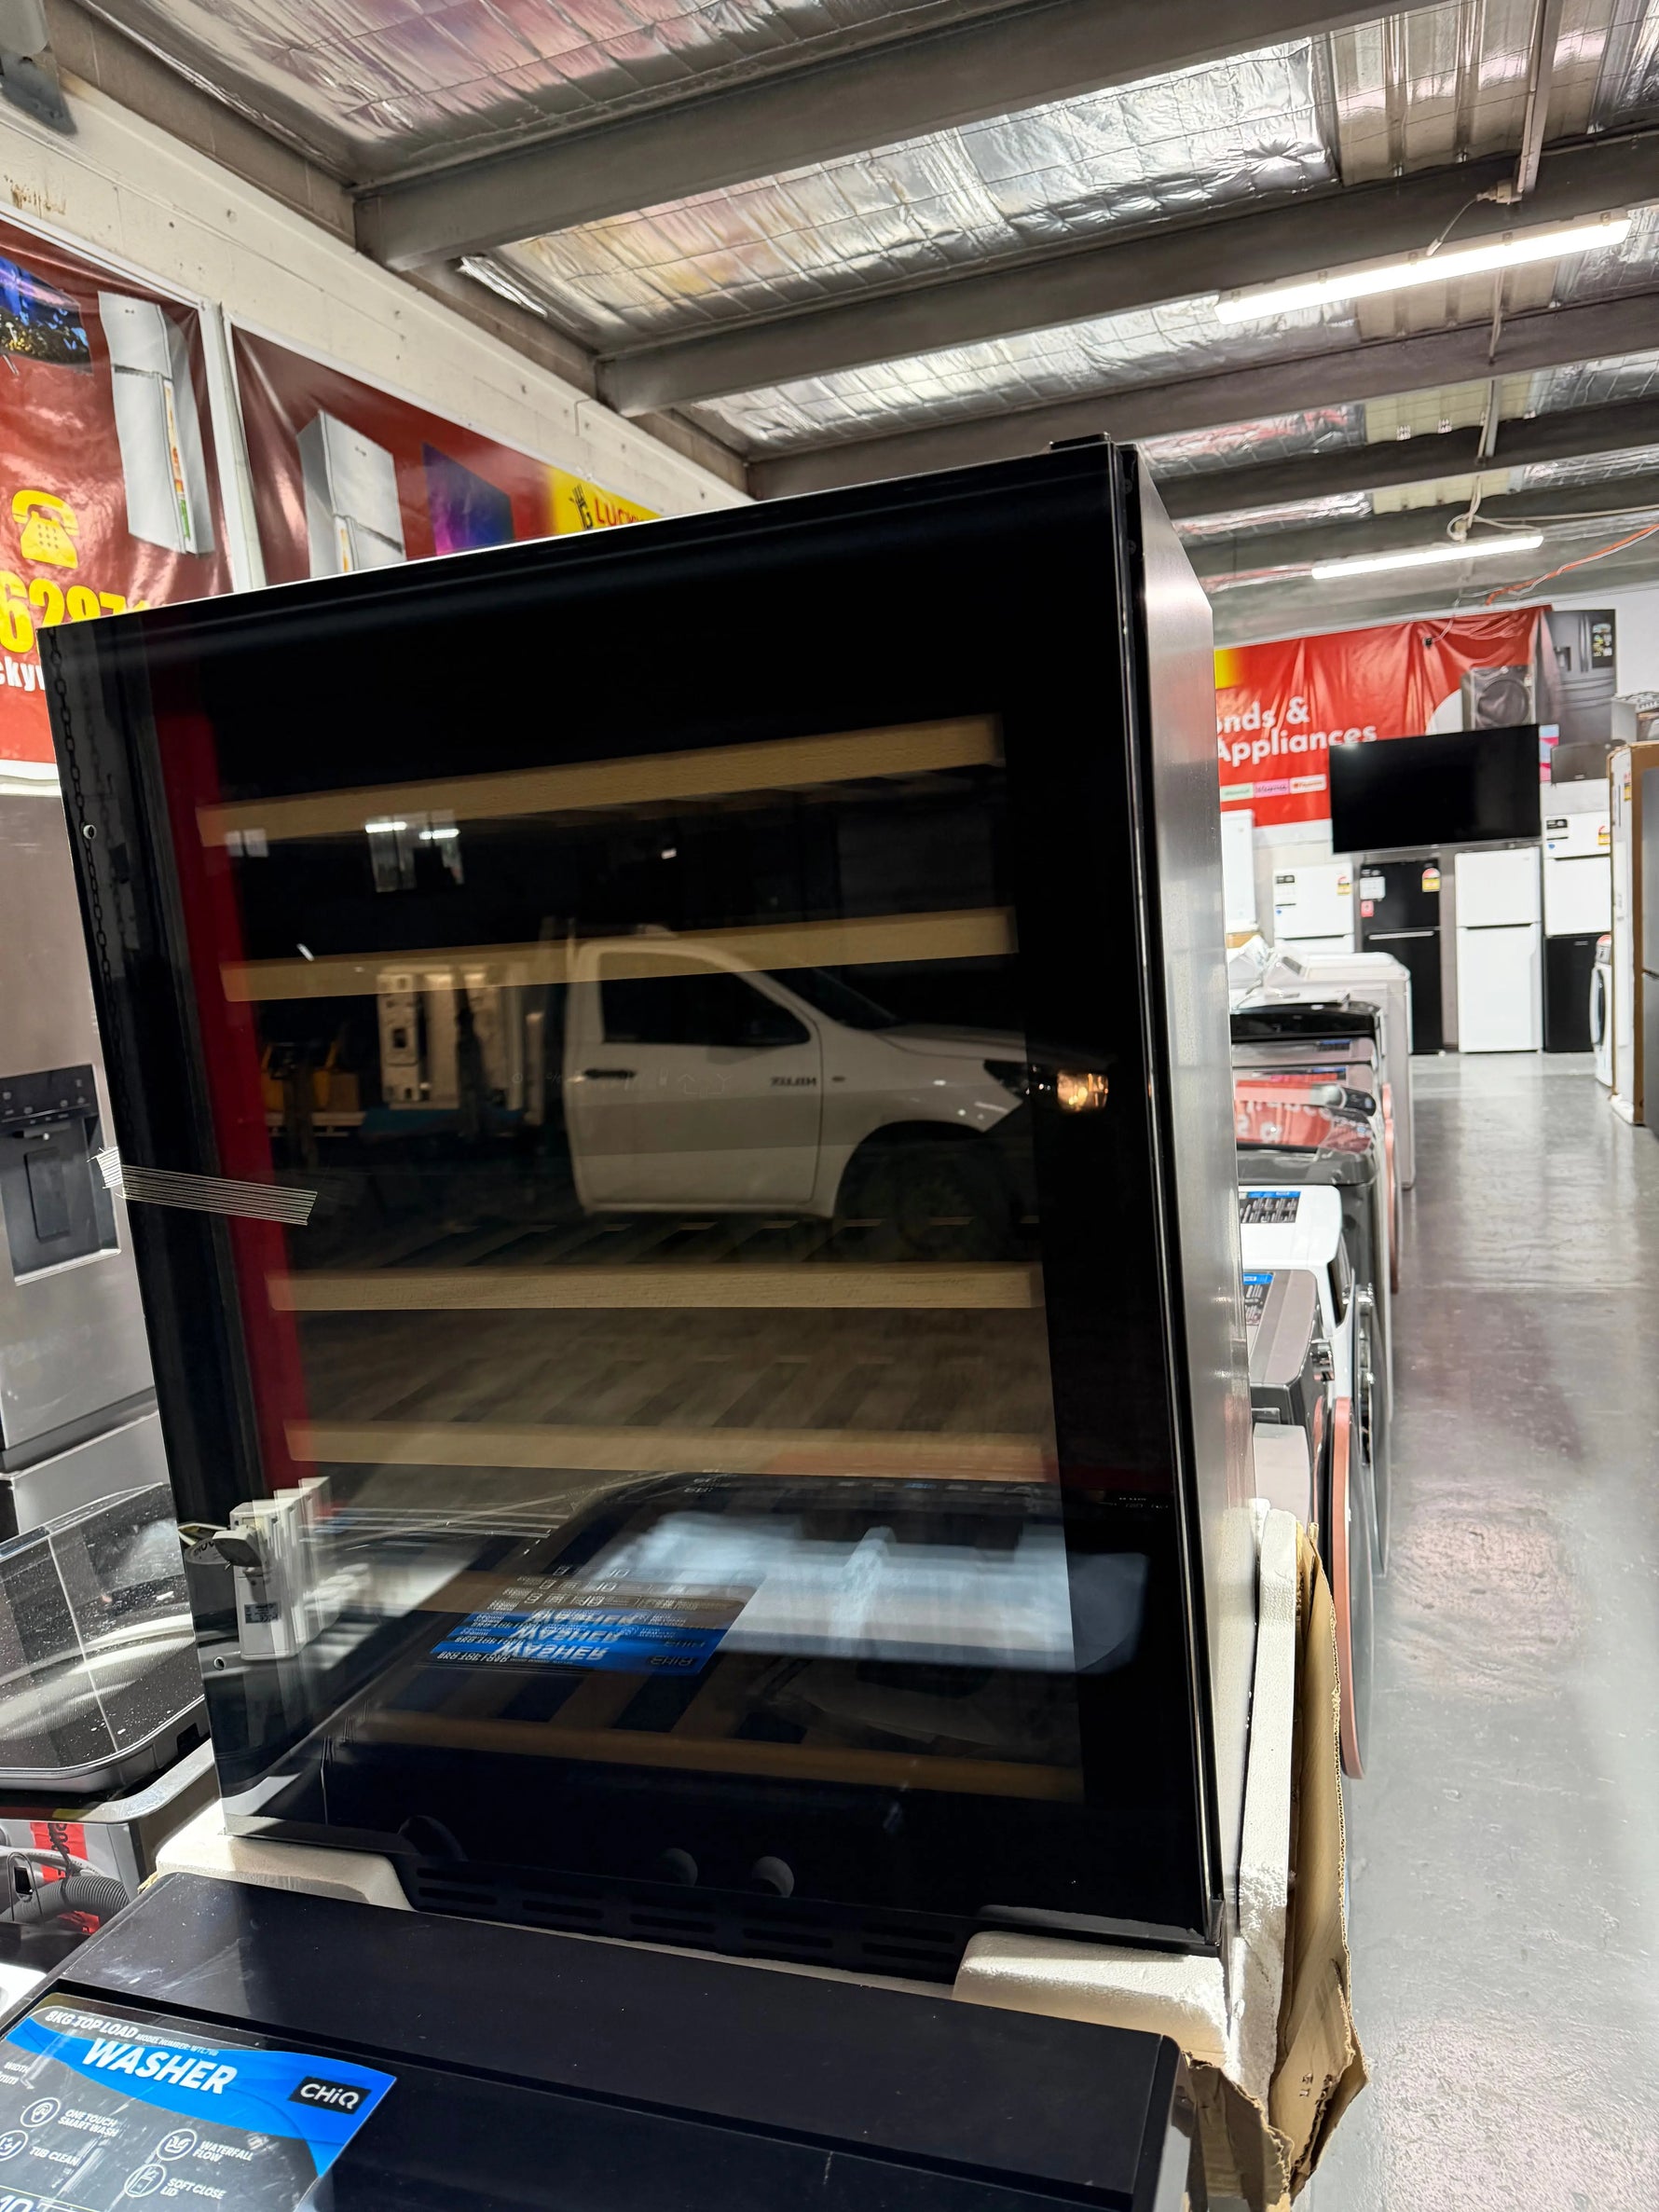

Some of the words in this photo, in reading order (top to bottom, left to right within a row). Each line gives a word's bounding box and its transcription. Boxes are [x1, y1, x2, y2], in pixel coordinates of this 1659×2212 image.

[1286, 695, 1310, 725] &
[45, 2010, 75, 2026] 8KG
[74, 2014, 102, 2031] TOP
[101, 2022, 139, 2040] LOAD
[82, 2037, 238, 2095] WASHER
[58, 2117, 92, 2131] SMART
[89, 2123, 120, 2137] WASH
[65, 2109, 87, 2122] ONE
[84, 2112, 118, 2128] TOUCH
[30, 2146, 50, 2159] TUB
[48, 2150, 82, 2166] CLEAN
[192, 2148, 224, 2163] FLOW
[199, 2140, 254, 2162] WATERFALL
[159, 2185, 179, 2197] LID
[167, 2178, 195, 2192] SOFT
[191, 2183, 226, 2200] CLOSE
